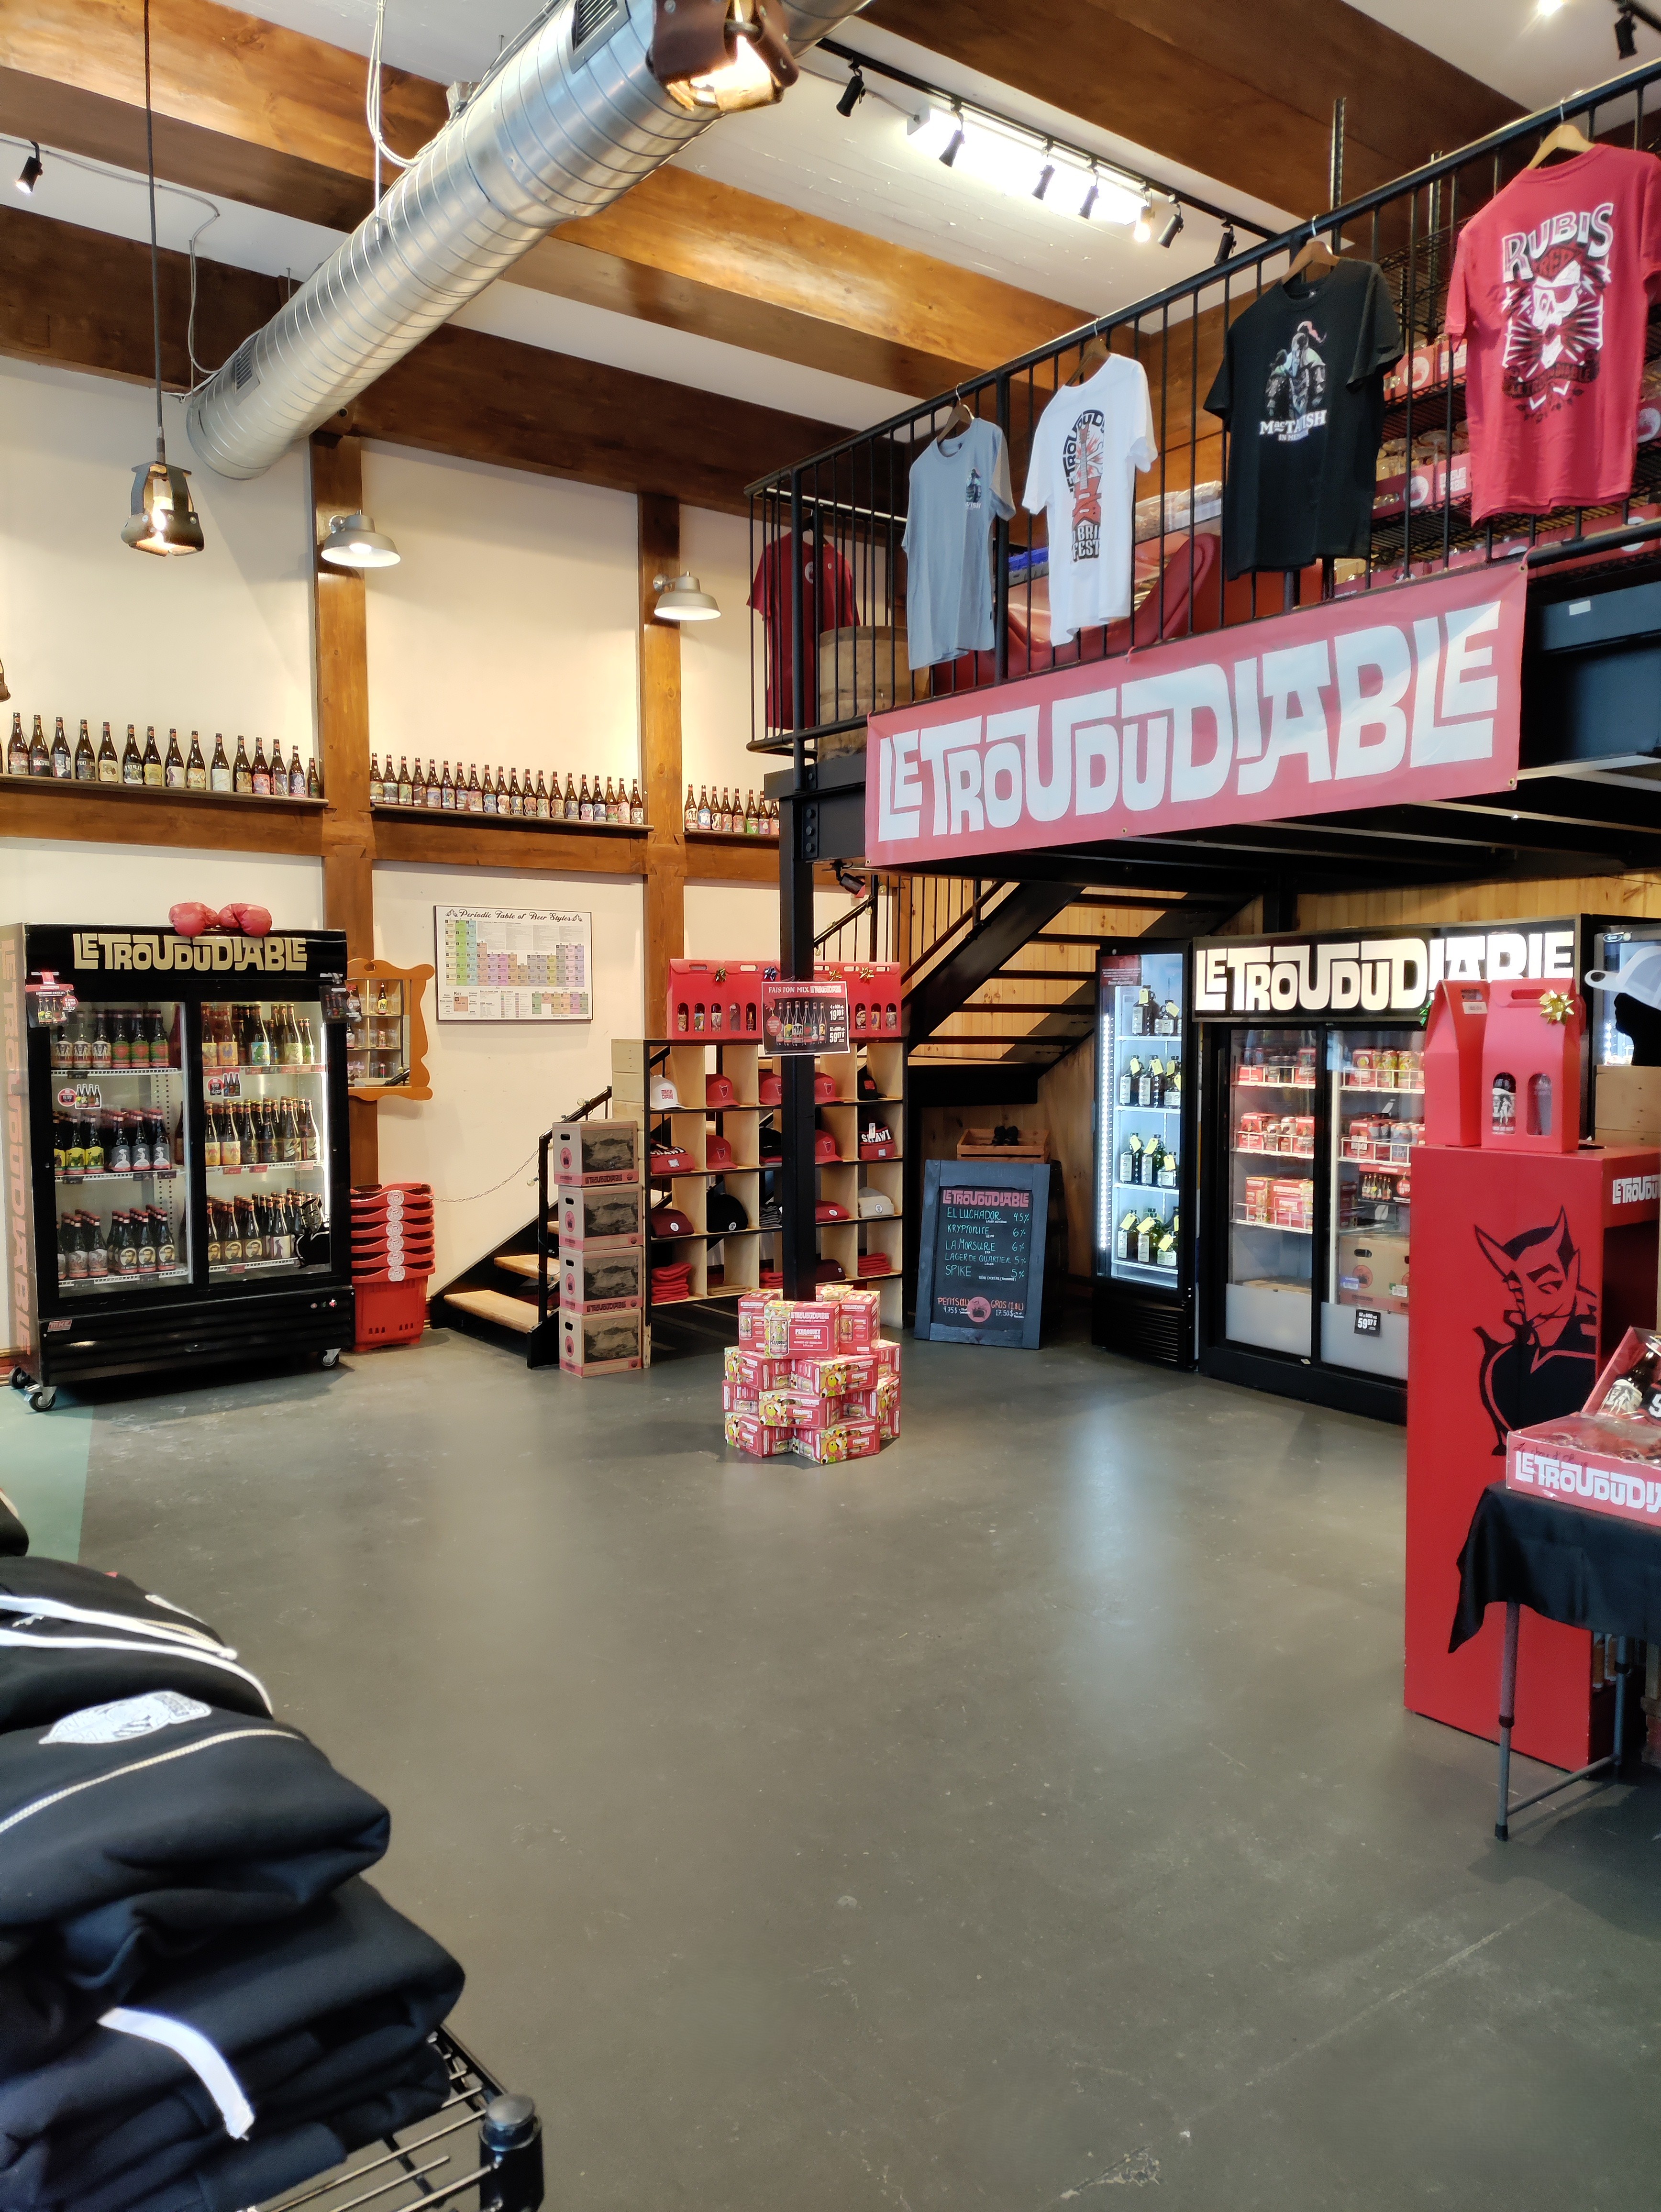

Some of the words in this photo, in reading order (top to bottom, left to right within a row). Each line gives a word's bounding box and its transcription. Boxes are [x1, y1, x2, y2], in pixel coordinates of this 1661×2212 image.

[1502, 202, 1614, 283] RUBIS
[458, 909, 492, 918] Periodic
[495, 910, 515, 919] Table
[529, 911, 547, 920] Beer
[549, 912, 572, 922] Styles
[959, 1208, 1001, 1221] LUCHADOR
[945, 1240, 956, 1250] LA
[945, 1253, 967, 1261] LAGER
[979, 1254, 1011, 1263] QUARTIER
[945, 1264, 972, 1277] SPIKE
[990, 1299, 1007, 1309] GROS
